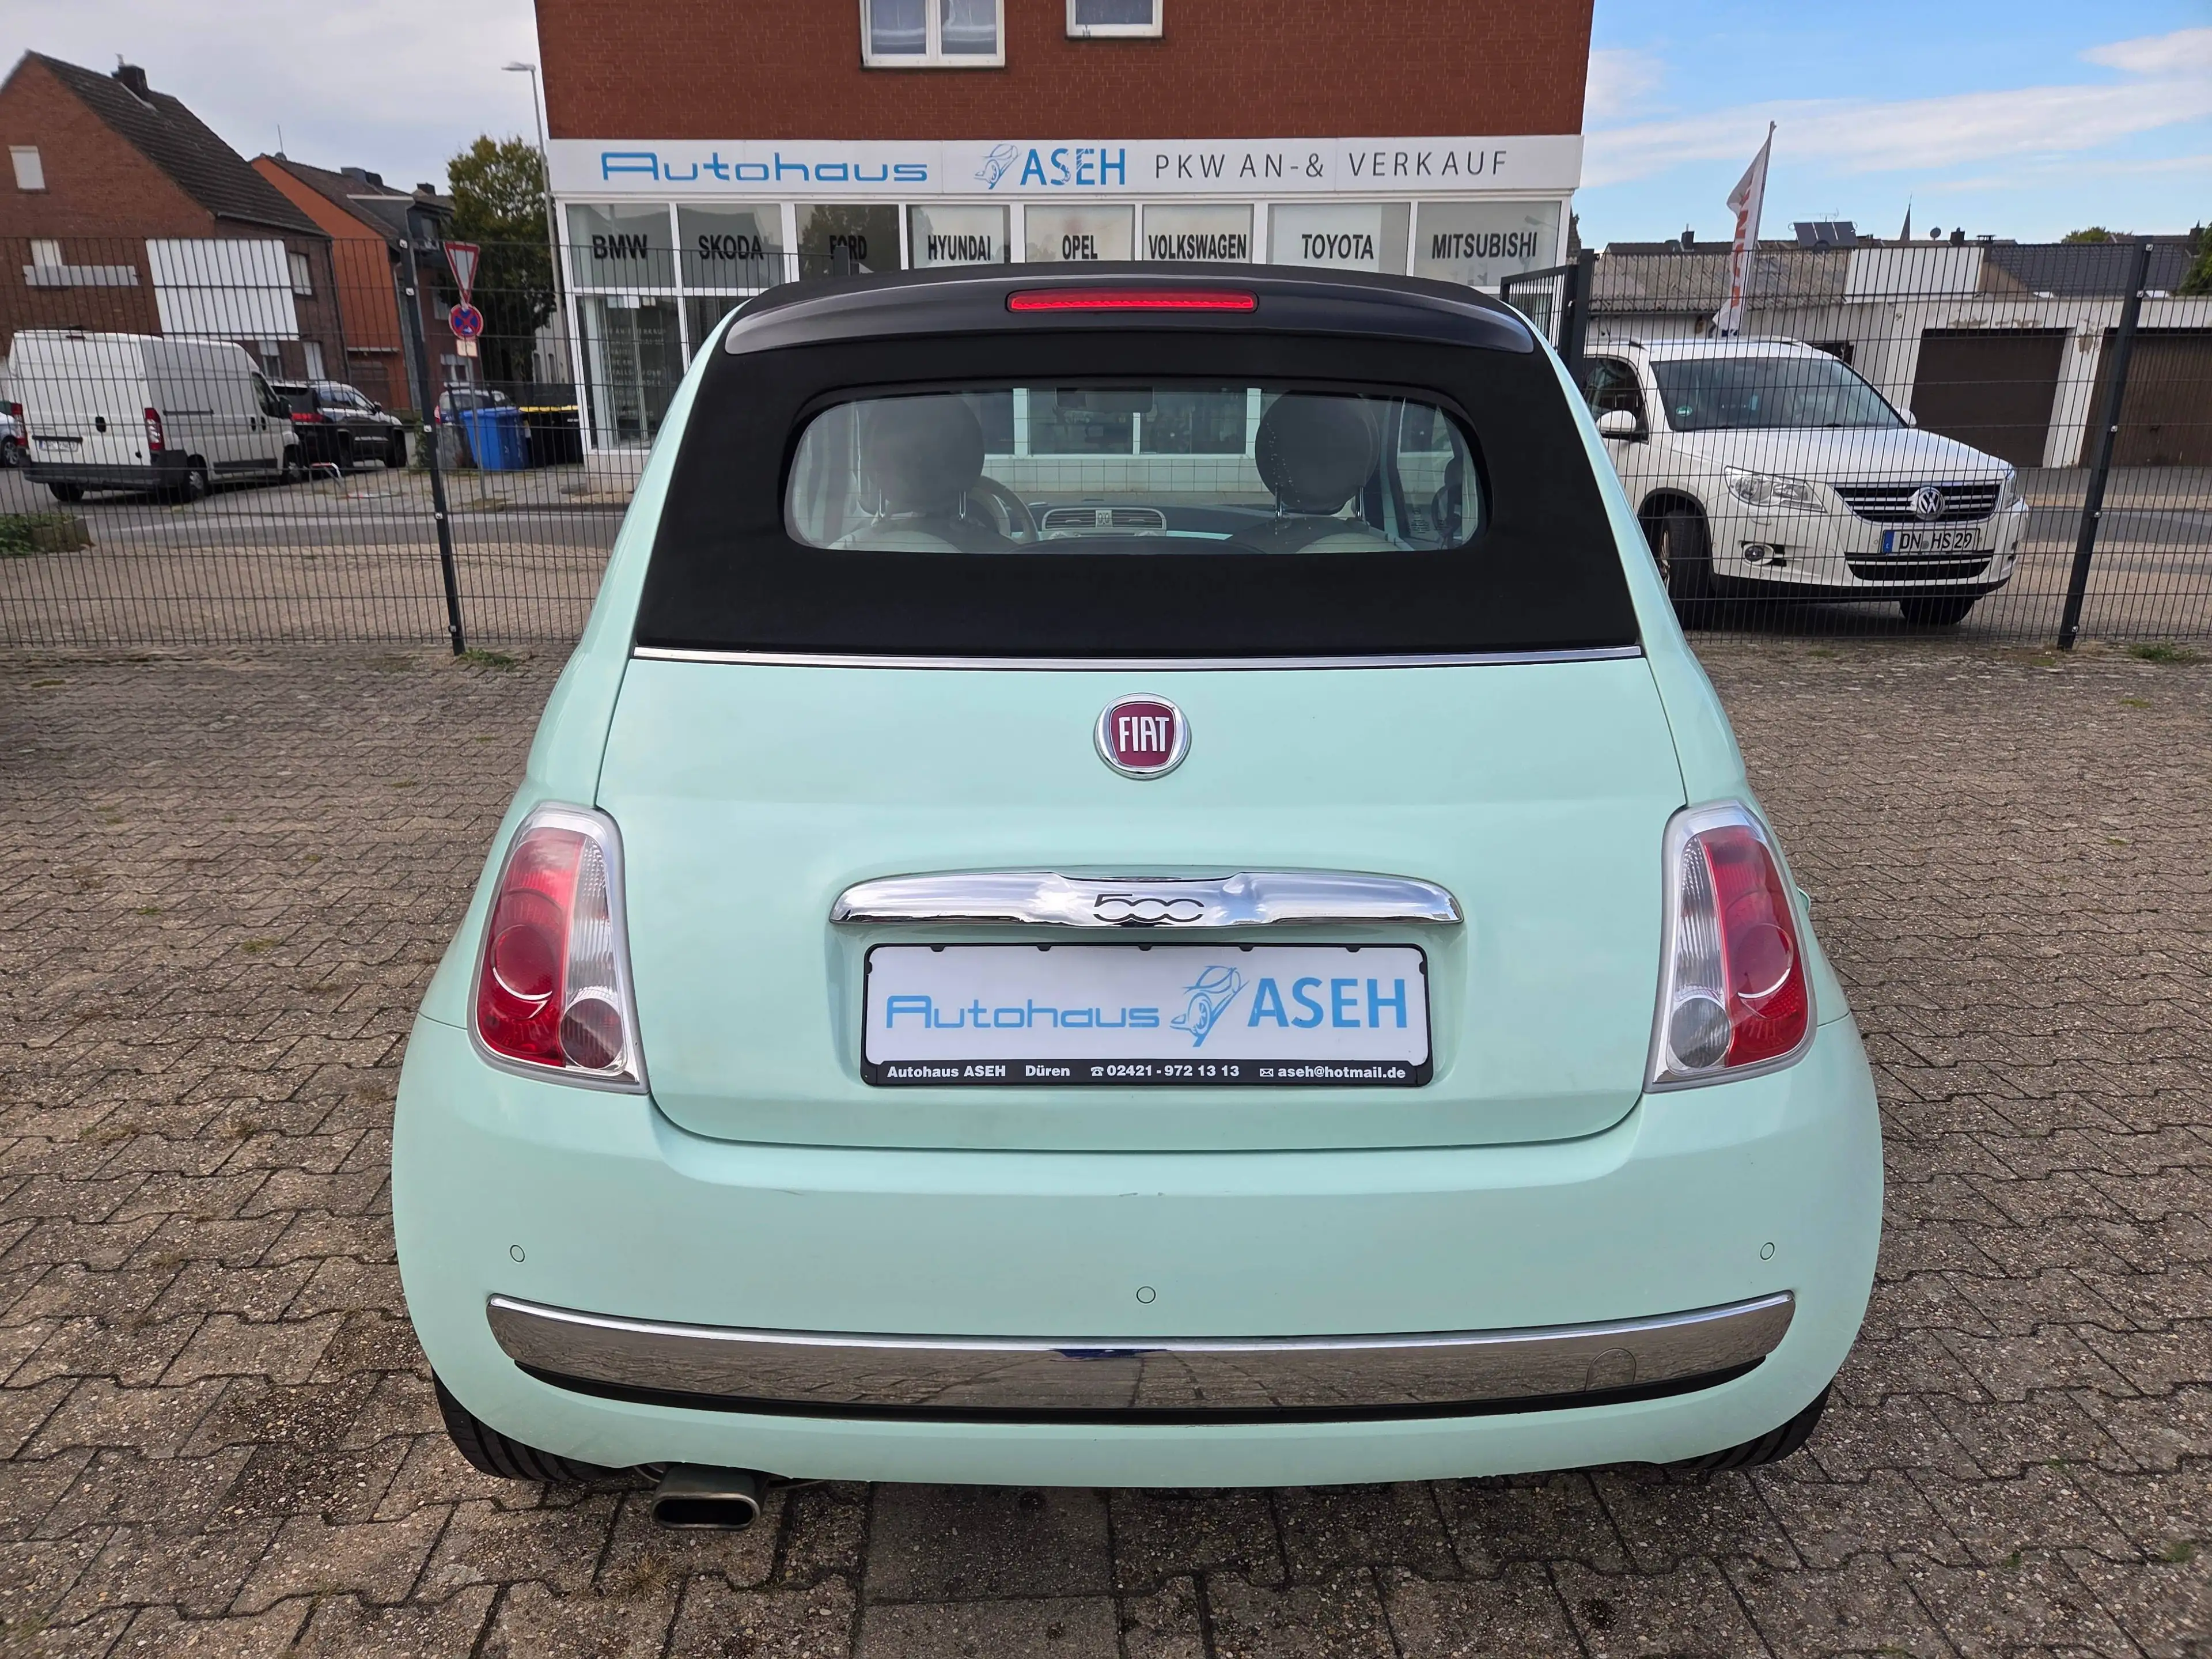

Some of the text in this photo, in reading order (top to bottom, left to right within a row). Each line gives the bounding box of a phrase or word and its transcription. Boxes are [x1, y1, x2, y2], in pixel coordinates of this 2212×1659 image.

[601, 151, 928, 183] Autohaus
[1020, 147, 1126, 187] ASEH
[1155, 153, 1226, 179] PKW
[1349, 150, 1507, 177] VERKAUF
[592, 234, 648, 260] BMW
[698, 234, 764, 260] SKODA
[927, 234, 991, 261] HYUNDAI
[1062, 234, 1098, 260] OPEL
[1149, 234, 1247, 260] VOLKSWAGEN
[1302, 234, 1374, 260] TOYOTA
[1431, 231, 1538, 260] MITSUBISHI
[1902, 533, 1922, 549] DN
[1119, 716, 1169, 752] FIAT
[1093, 893, 1205, 922] 500
[885, 976, 1408, 1029] Autohaus ASEH
[887, 1066, 959, 1078] Autohaus
[963, 1065, 1006, 1077] ASEH
[1025, 1065, 1070, 1077] Düren
[1198, 1065, 1216, 1077] 13
[1221, 1065, 1240, 1077] 13
[1278, 1066, 1406, 1078] aseh@hotmail.de
